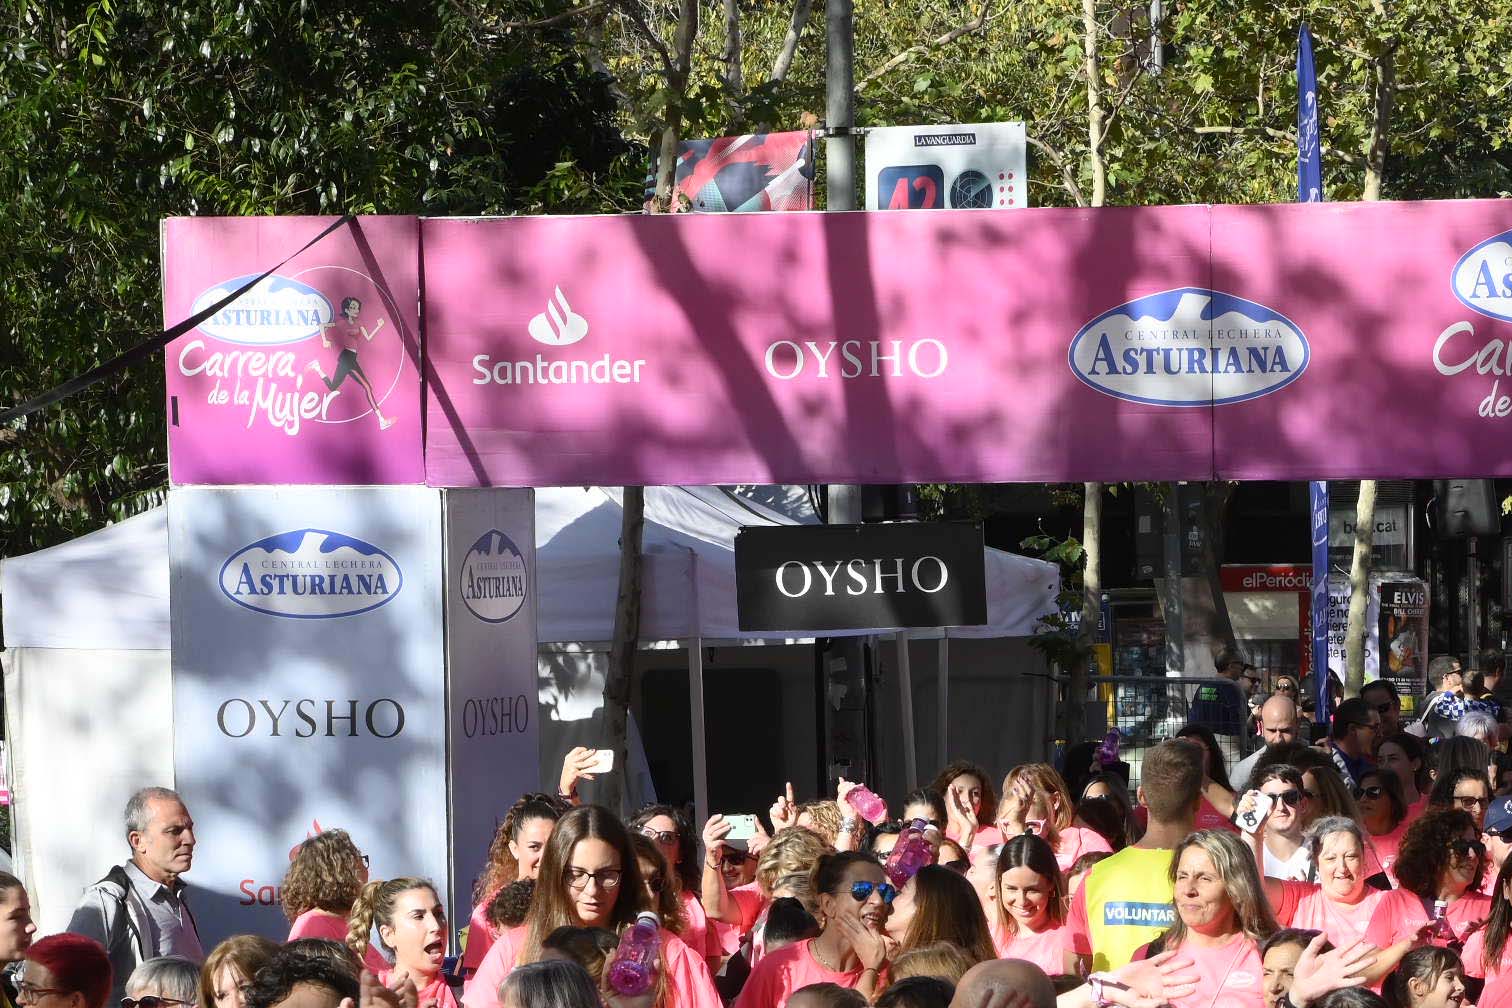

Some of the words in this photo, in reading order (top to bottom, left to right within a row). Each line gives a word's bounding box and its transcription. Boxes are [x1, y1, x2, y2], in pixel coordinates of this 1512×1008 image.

[925, 133, 976, 146] VANGUARDIA
[1125, 328, 1200, 341] CENTRAL
[1208, 327, 1284, 340] LECHERA
[178, 340, 297, 377] Carrera
[473, 353, 646, 386] Santander
[764, 338, 948, 379] OYSHO
[1088, 332, 1291, 377] ASTURIANA
[207, 381, 229, 405] de
[234, 381, 250, 405] la
[247, 374, 341, 436] Mujer
[1478, 380, 1512, 418] de
[234, 562, 390, 597] ASTURIANA
[262, 560, 320, 570] CENTRAL
[325, 560, 384, 570] LECHERA
[465, 565, 524, 600] ASTURIANA
[774, 556, 949, 598] OYSHO
[1393, 591, 1424, 604] ELVIS
[216, 697, 406, 738] OYSHO
[462, 694, 529, 738] OYSHO
